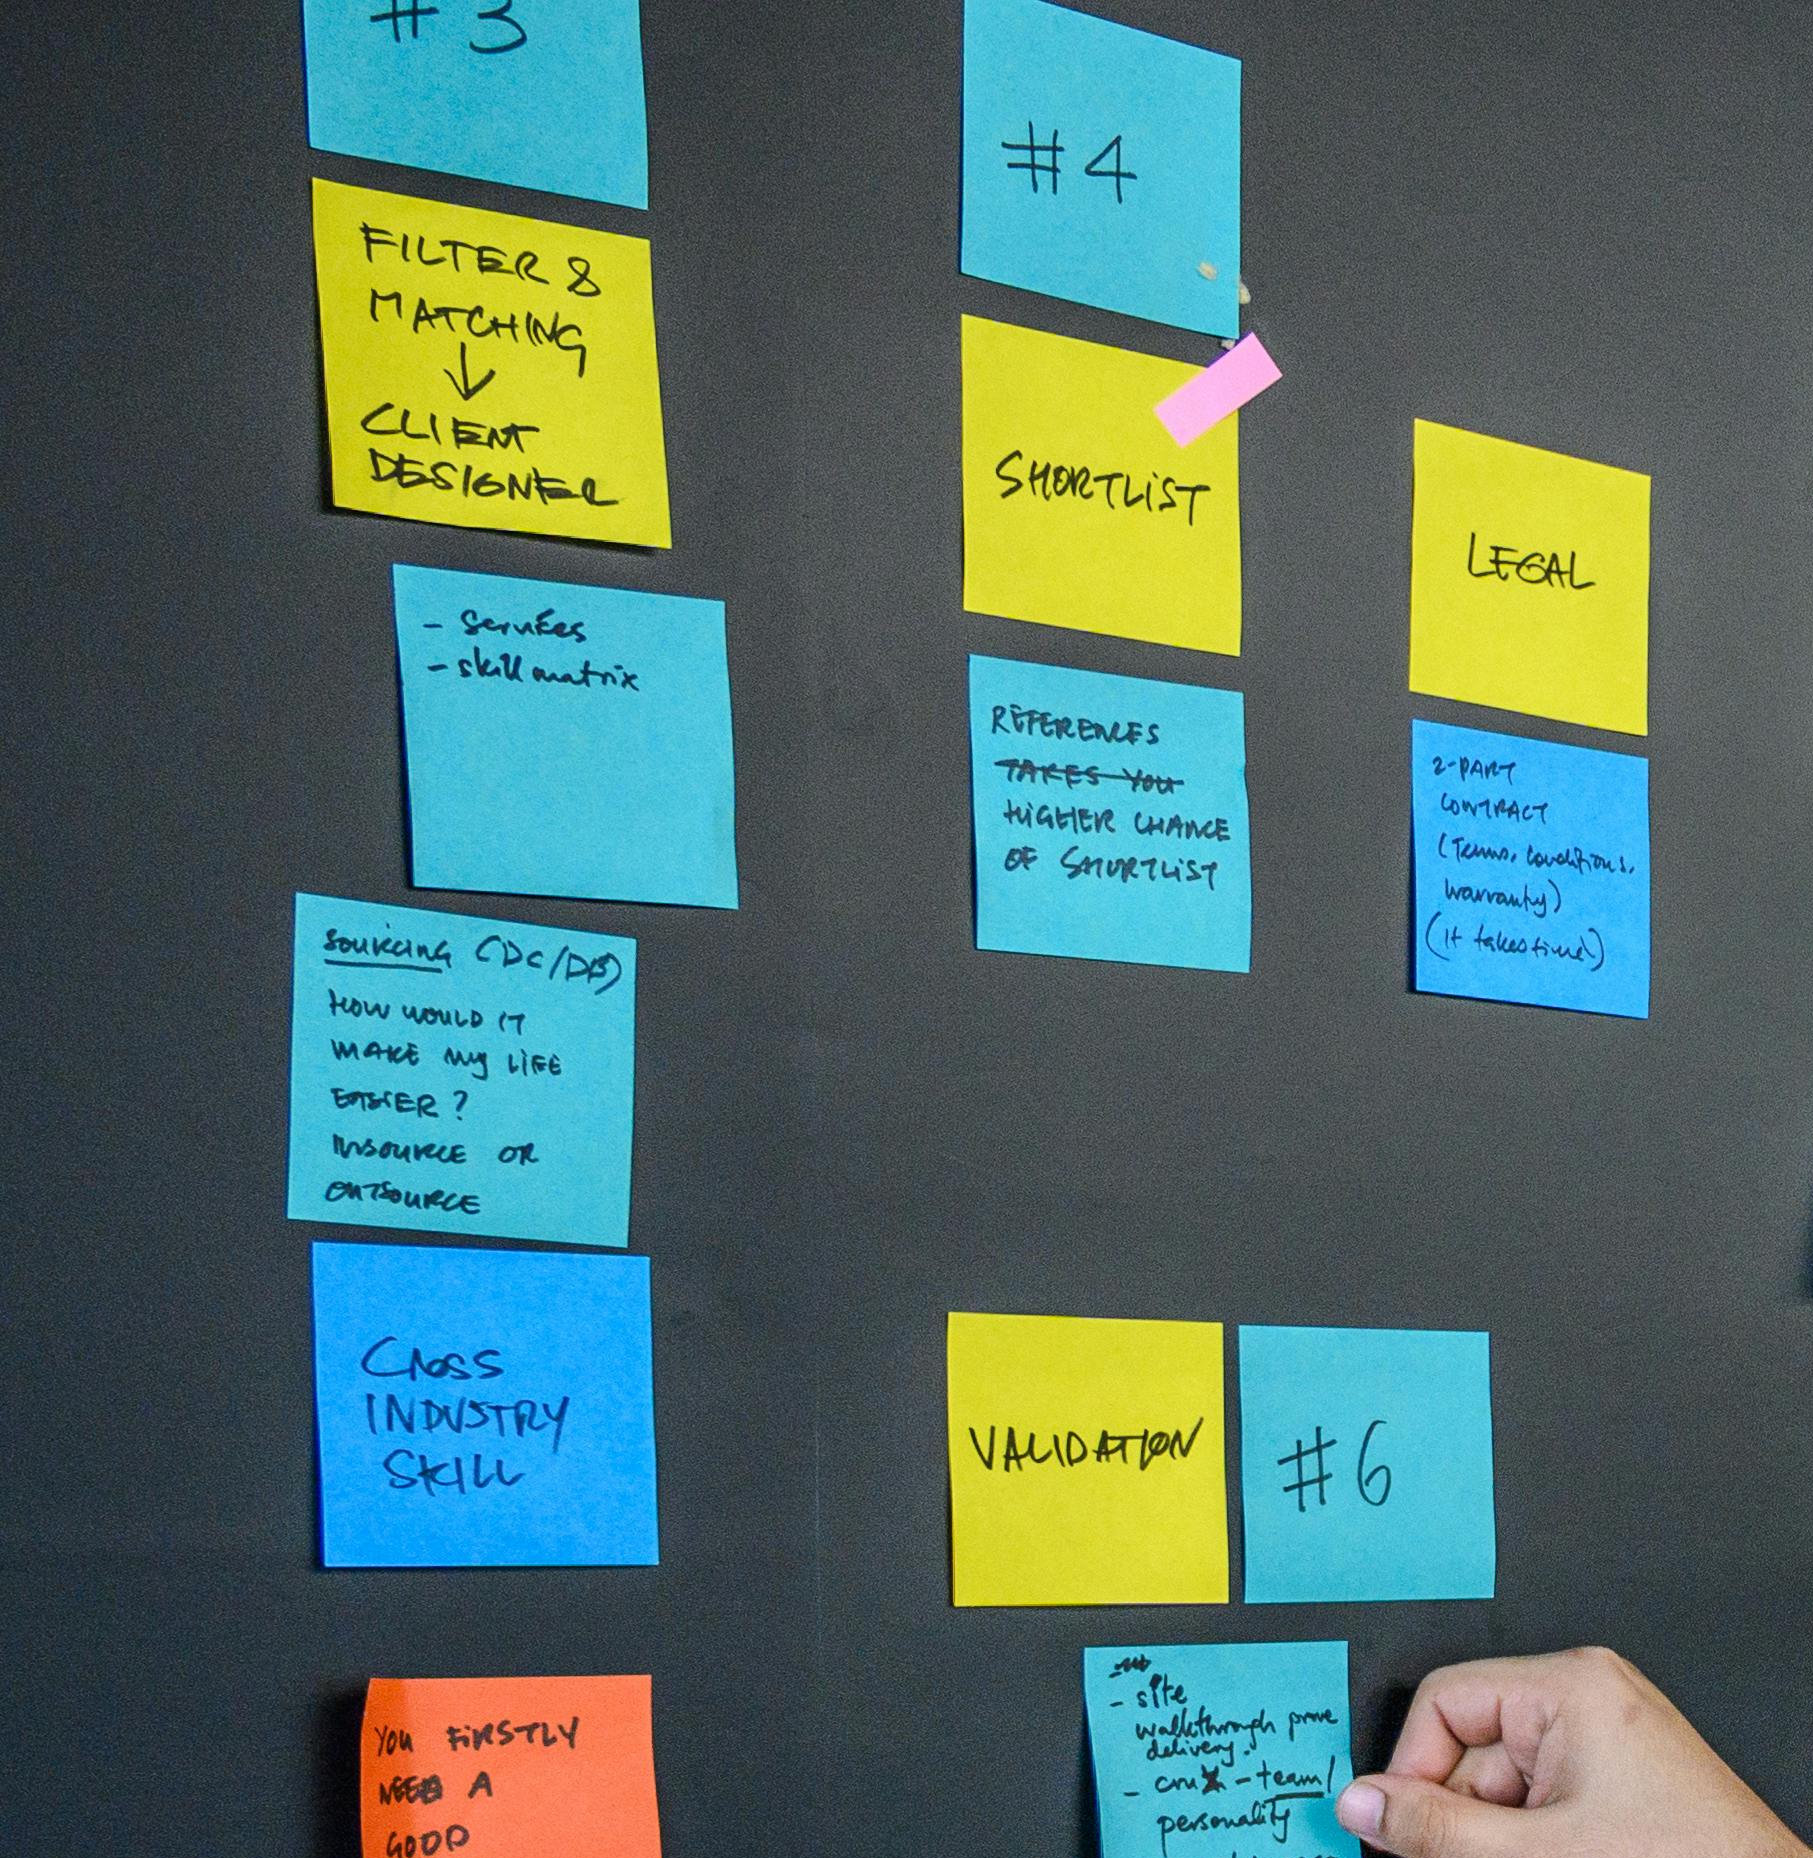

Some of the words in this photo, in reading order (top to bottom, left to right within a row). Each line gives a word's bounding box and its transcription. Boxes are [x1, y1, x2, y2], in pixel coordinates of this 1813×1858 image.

[359, 222, 550, 286] FILTER
[369, 288, 587, 378] MATCHING
[359, 402, 540, 453] CLIENT
[368, 447, 620, 508] DESIGNER
[994, 449, 1213, 527] SHORTLIST
[1467, 531, 1598, 590] LEGAL
[990, 703, 1161, 746] REFERENCES
[1002, 798, 1118, 836] HIGHER
[1133, 811, 1233, 843] CHANCE
[1440, 792, 1550, 825] CONTRACT
[1003, 845, 1038, 873] OF
[329, 988, 392, 1020] HOW
[402, 1004, 485, 1029] WOULD
[499, 1012, 527, 1036] IT
[329, 1038, 421, 1067] MAKE
[498, 1142, 541, 1166] OR
[324, 1179, 482, 1216] OUTSOURCE
[365, 1392, 572, 1455] INDUSTRY
[967, 1416, 1205, 1474] VALIDATION
[382, 1448, 528, 1498] SKILL
[373, 1725, 415, 1758] YOU
[445, 1715, 581, 1752] FIRSTLY
[1135, 1704, 1277, 1753] walkthrough
[466, 1769, 494, 1800] A
